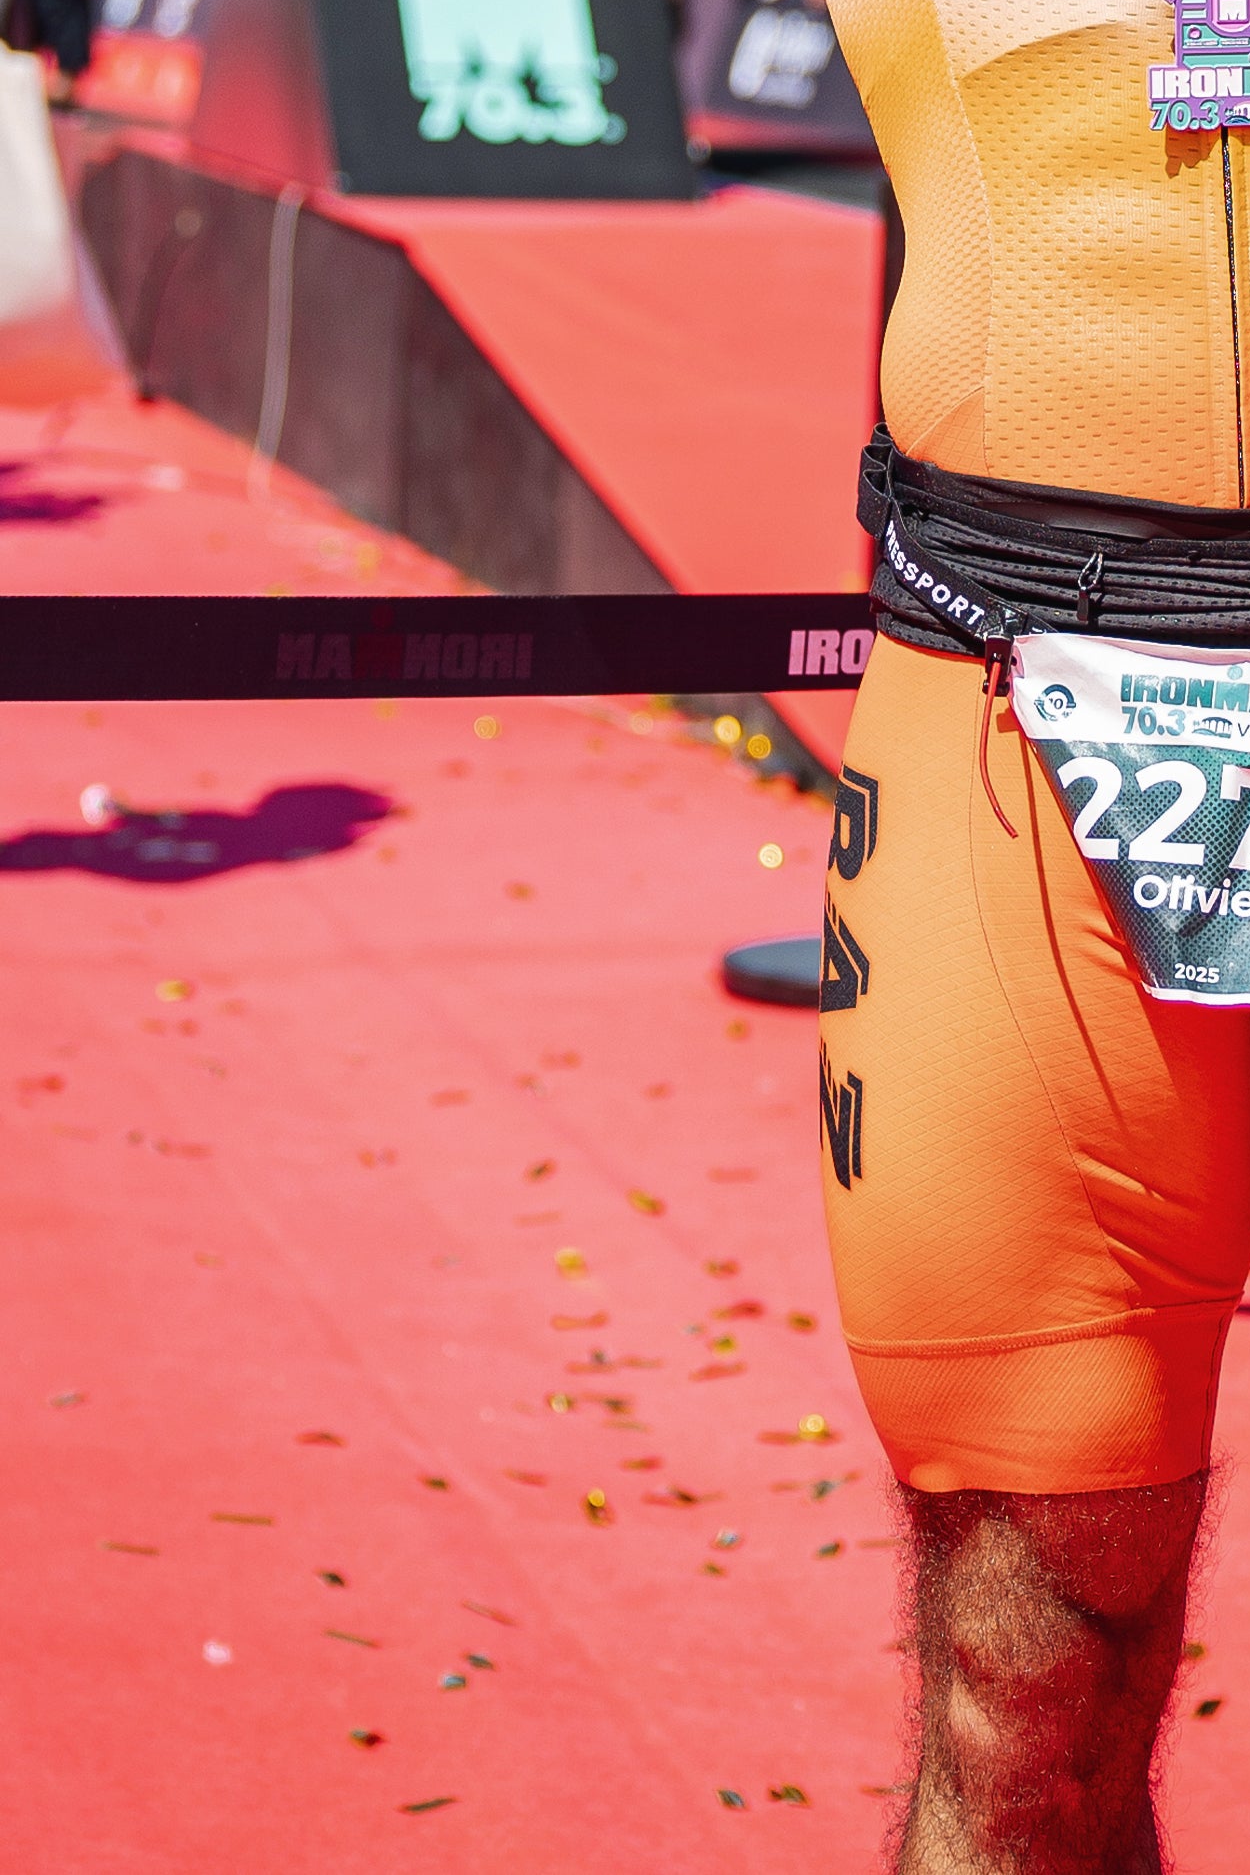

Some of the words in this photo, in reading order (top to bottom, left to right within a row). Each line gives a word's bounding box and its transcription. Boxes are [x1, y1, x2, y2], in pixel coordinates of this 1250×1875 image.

[1151, 100, 1220, 130] 70.3
[1122, 706, 1186, 737] 70.3
[1174, 963, 1220, 984] 2025
